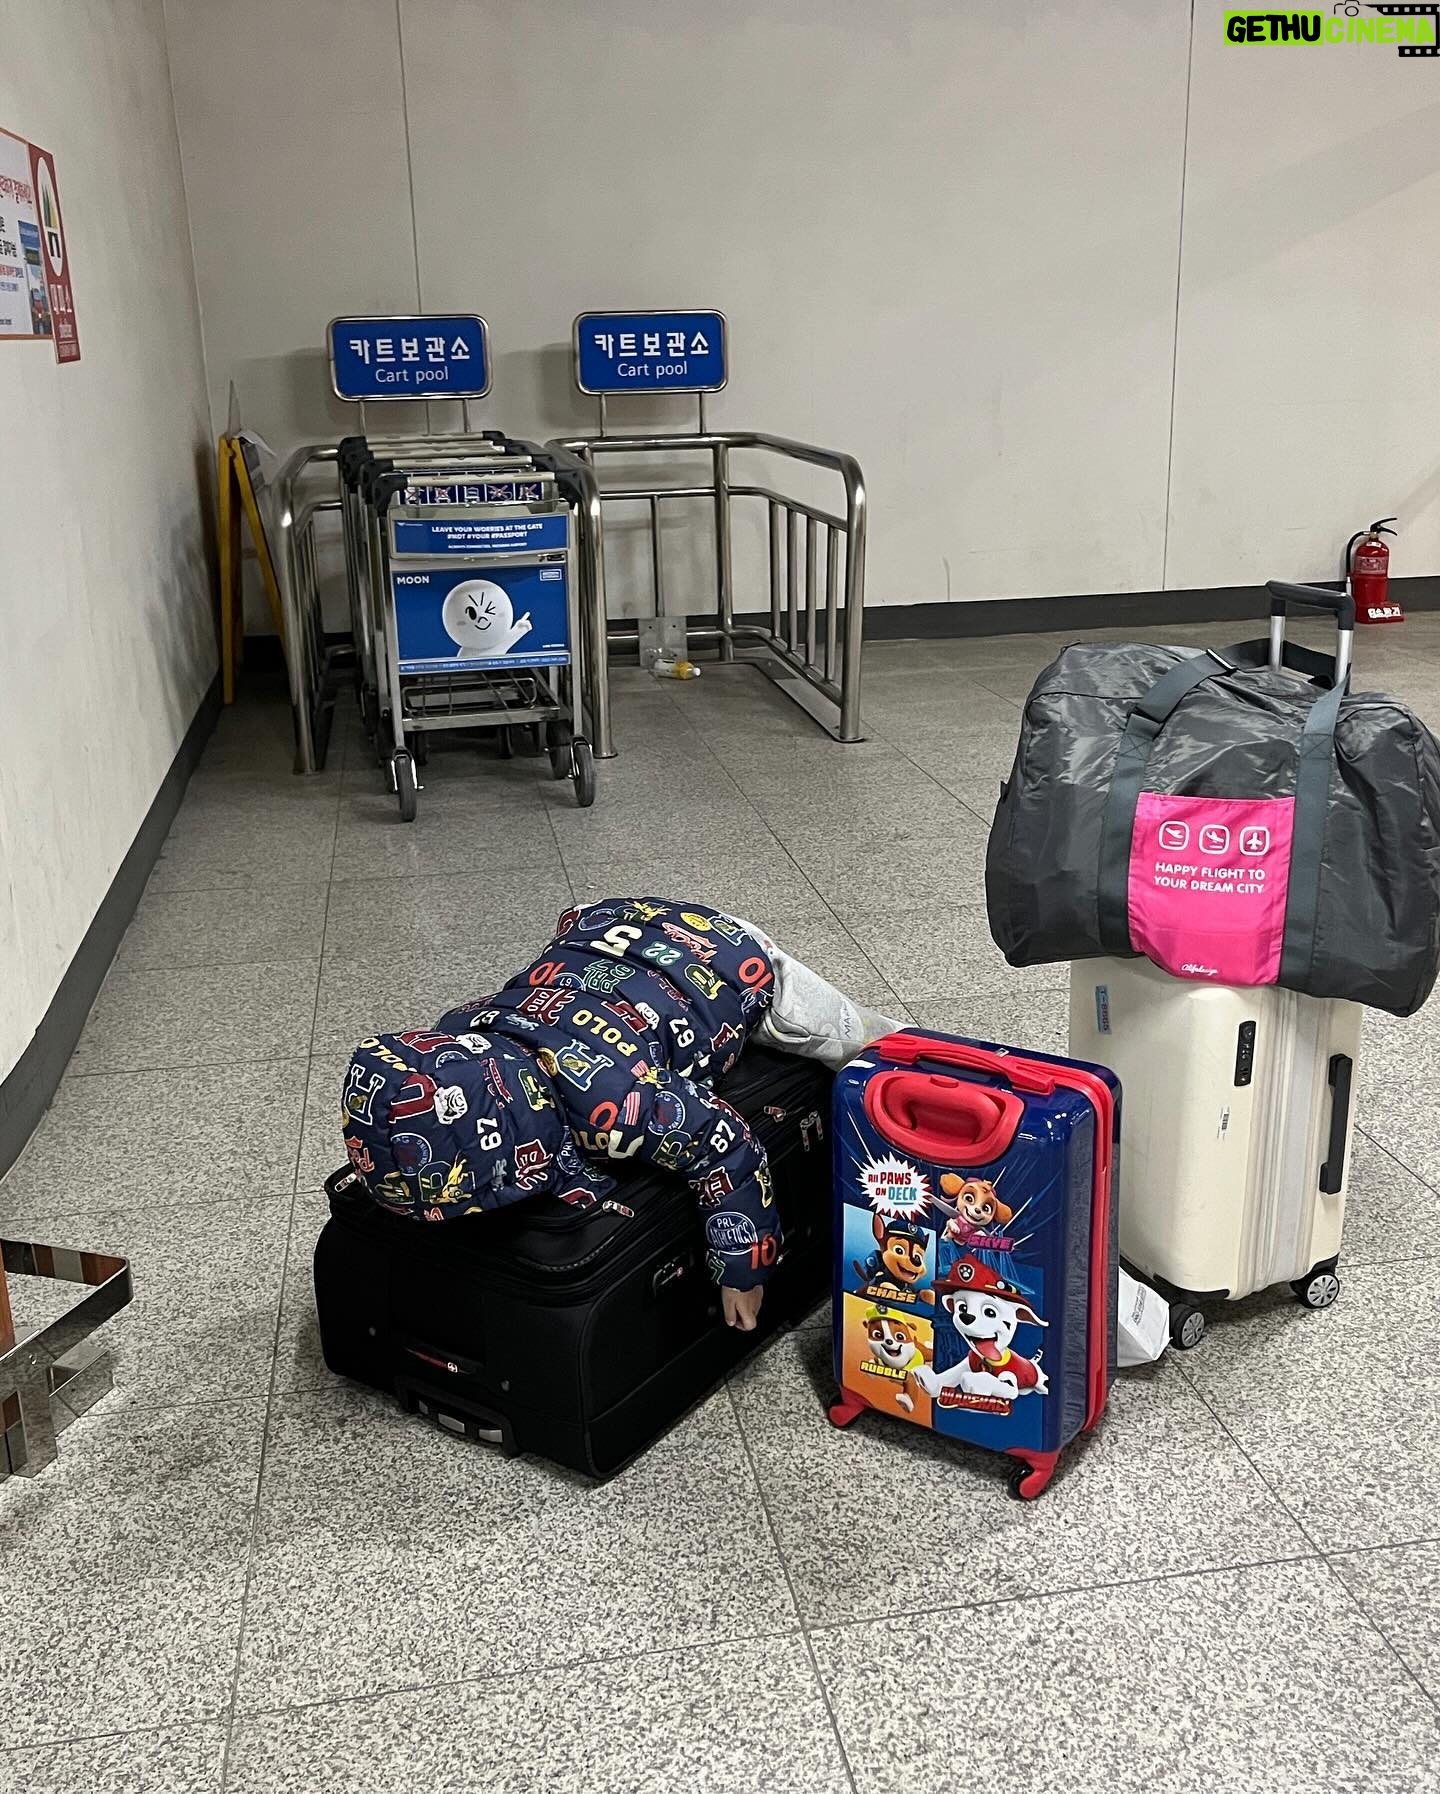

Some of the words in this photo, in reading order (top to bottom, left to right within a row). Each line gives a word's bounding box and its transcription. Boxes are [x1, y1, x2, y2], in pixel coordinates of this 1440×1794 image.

[349, 336, 471, 364] 카트보관소
[593, 331, 710, 359] 카트보관소
[375, 368, 409, 383] Cart
[415, 366, 449, 385] pool
[616, 363, 650, 377] Cart
[655, 361, 688, 381] pool
[397, 575, 430, 585] MOON
[1155, 862, 1199, 877] HAPPY
[1201, 867, 1245, 880] FLIGHT
[1248, 869, 1266, 881] TO
[1153, 875, 1187, 890] YOUR
[1190, 880, 1234, 894] DREAM
[1237, 883, 1265, 895] CITY
[643, 942, 682, 965] 22
[571, 1009, 638, 1057] POLO
[668, 1016, 695, 1048] 67
[476, 1117, 502, 1151] 67
[880, 1172, 912, 1185] PAWS
[888, 1186, 917, 1201] DECK
[716, 1217, 735, 1229] PRL
[710, 1221, 753, 1250] ATHLETICS
[969, 1236, 1012, 1251] SKYE
[751, 1233, 777, 1270] 10
[866, 1286, 917, 1303] CHASE
[860, 1361, 908, 1380] RUBBLE
